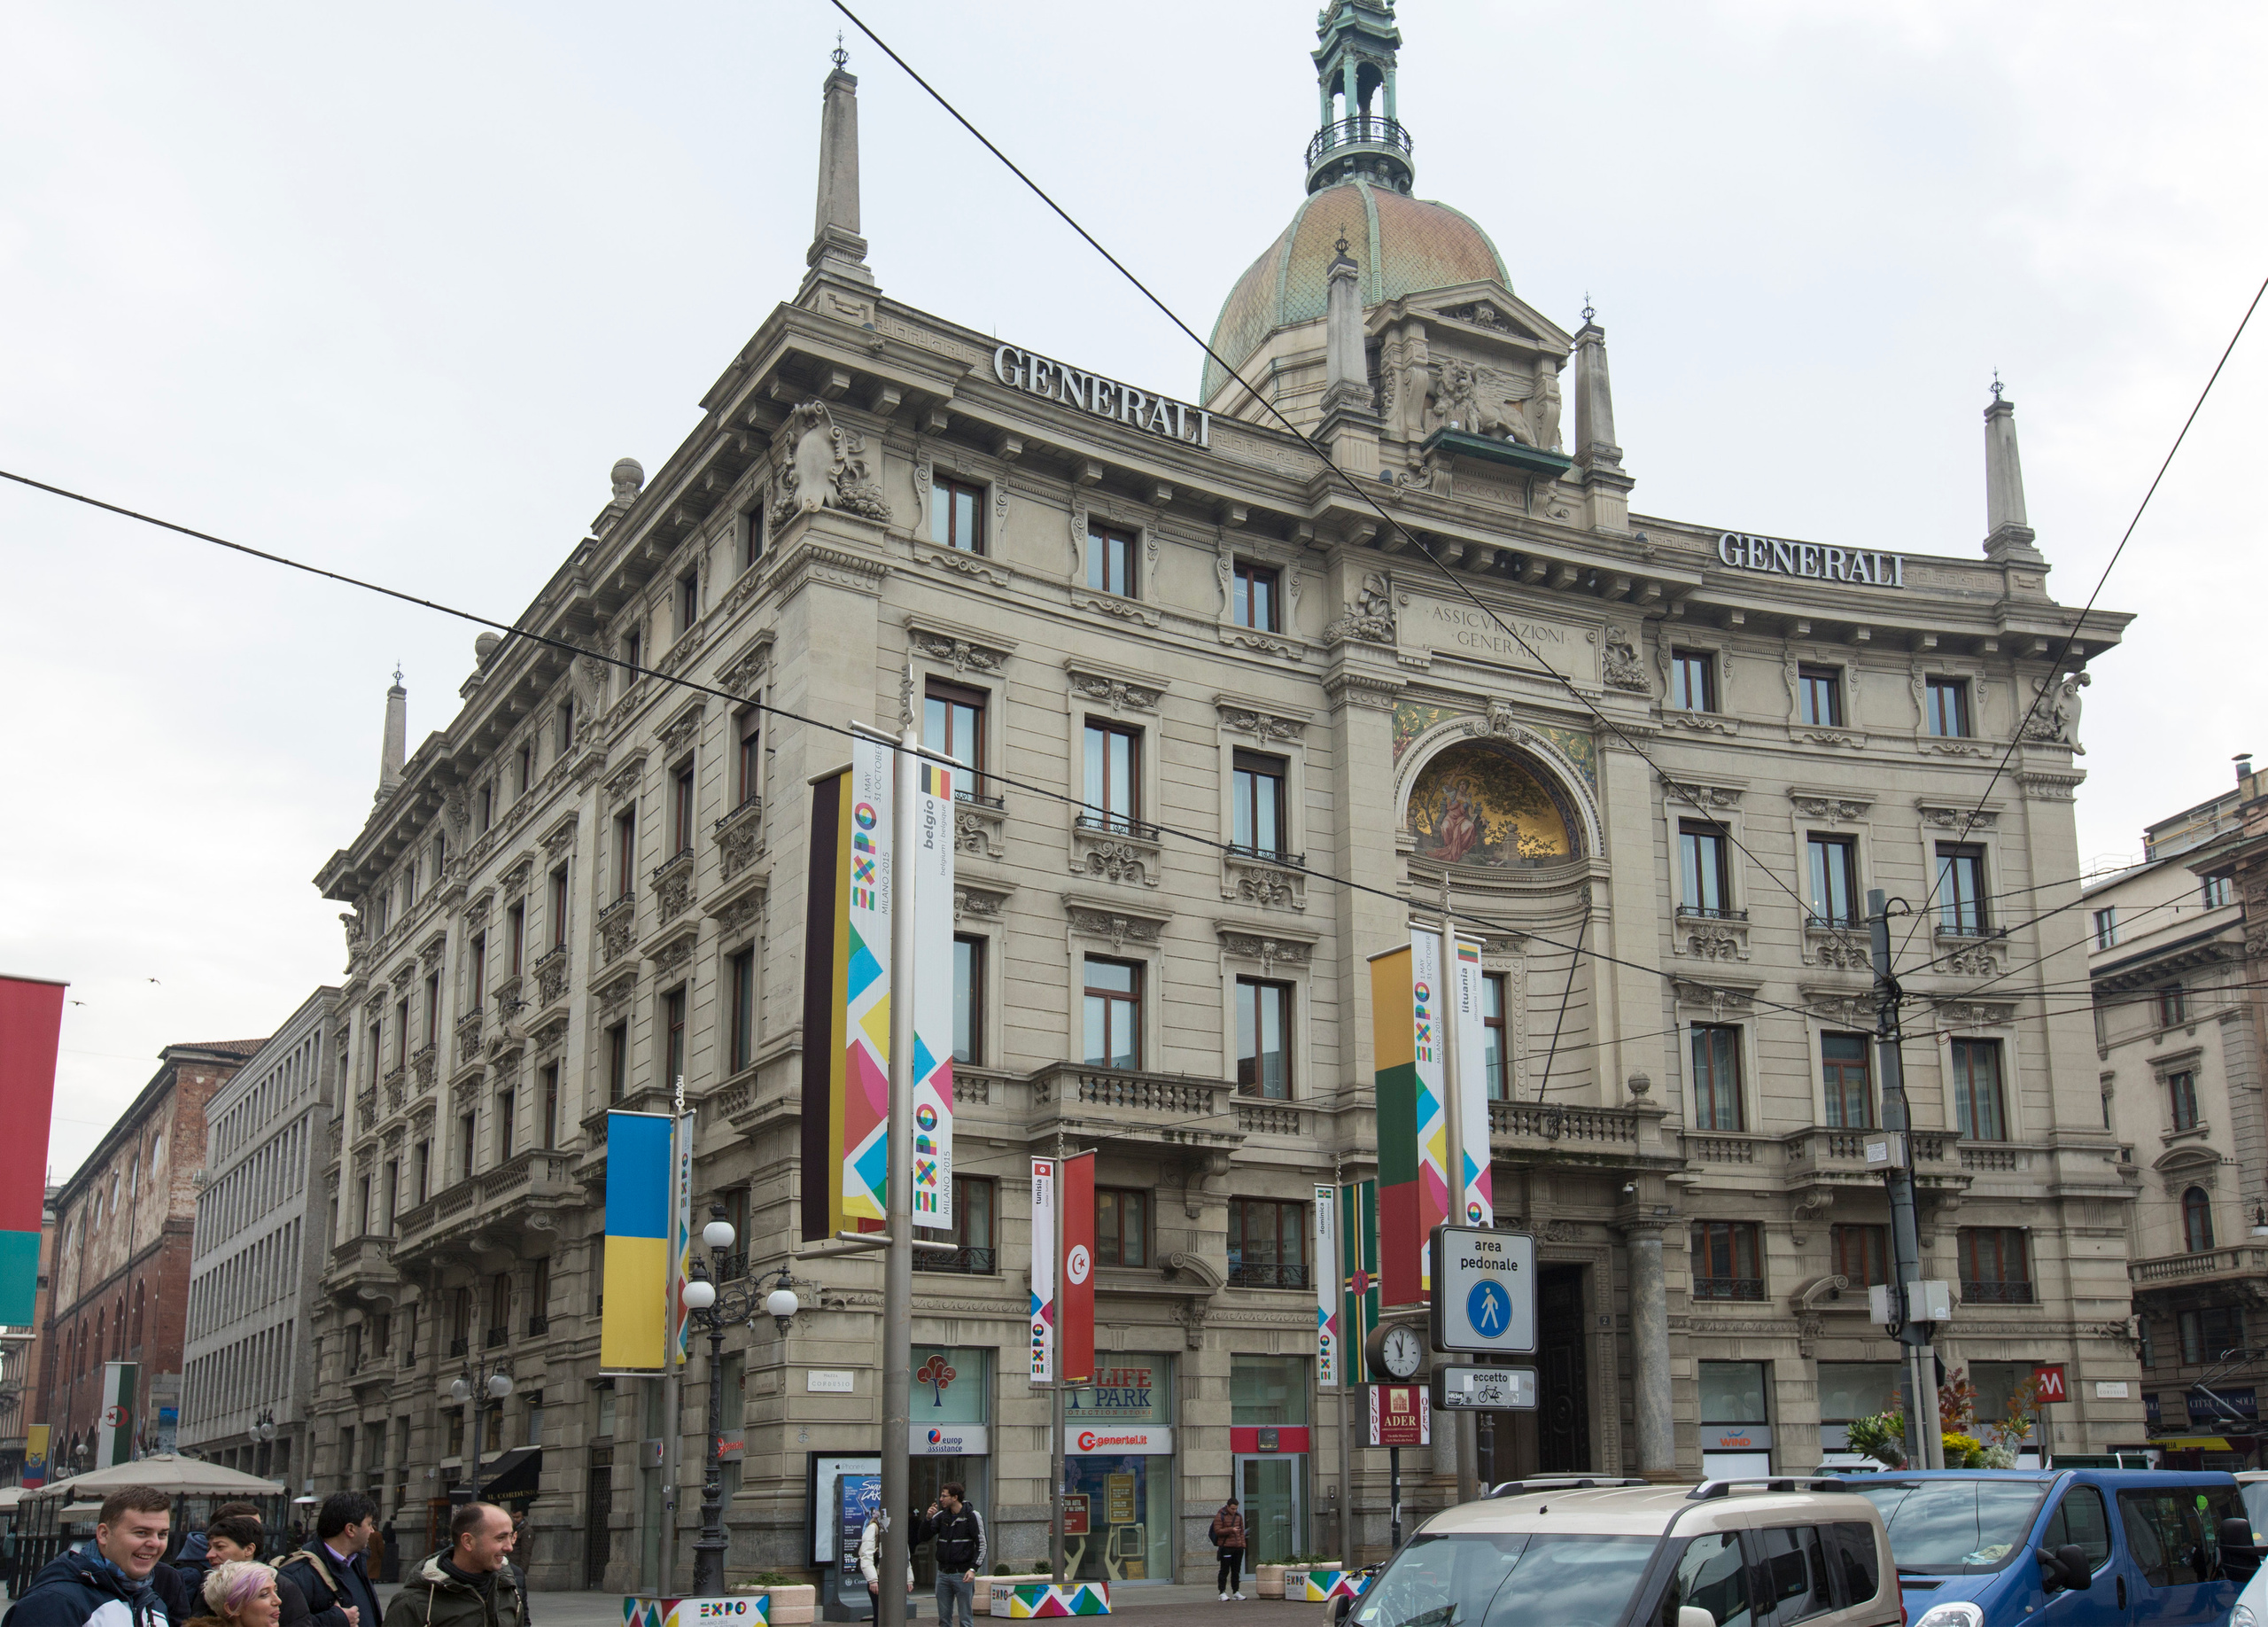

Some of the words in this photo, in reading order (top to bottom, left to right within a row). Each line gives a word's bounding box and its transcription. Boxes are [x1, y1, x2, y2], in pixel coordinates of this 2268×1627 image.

[994, 345, 1212, 450] GENERALI
[1718, 532, 1905, 588] GENERALI
[1457, 631, 1541, 658] GENERALI
[874, 792, 882, 802] 31
[923, 799, 934, 850] belgio
[852, 802, 877, 911] EXPO
[1426, 972, 1432, 981] 31
[1461, 968, 1470, 1014] lituania
[1415, 981, 1432, 1063] EXPO
[915, 1103, 937, 1213] EXPO
[1475, 1241, 1502, 1252] area
[1461, 1257, 1518, 1271] pedonale
[1032, 1323, 1044, 1374] EXPO
[1320, 1335, 1331, 1380] EXPO
[1094, 1368, 1152, 1388] LIFE
[1473, 1373, 1508, 1382] eccetto
[2039, 1373, 2063, 1395] M
[1095, 1388, 1152, 1407] PARK
[1384, 1415, 1417, 1426] ADER
[942, 1436, 962, 1445] europ
[1097, 1435, 1147, 1446] genertel.it
[861, 1490, 881, 1501] LAK
[1286, 1576, 1304, 1585] EXPO
[992, 1589, 1008, 1600] EXPO
[701, 1601, 747, 1617] EXPO
